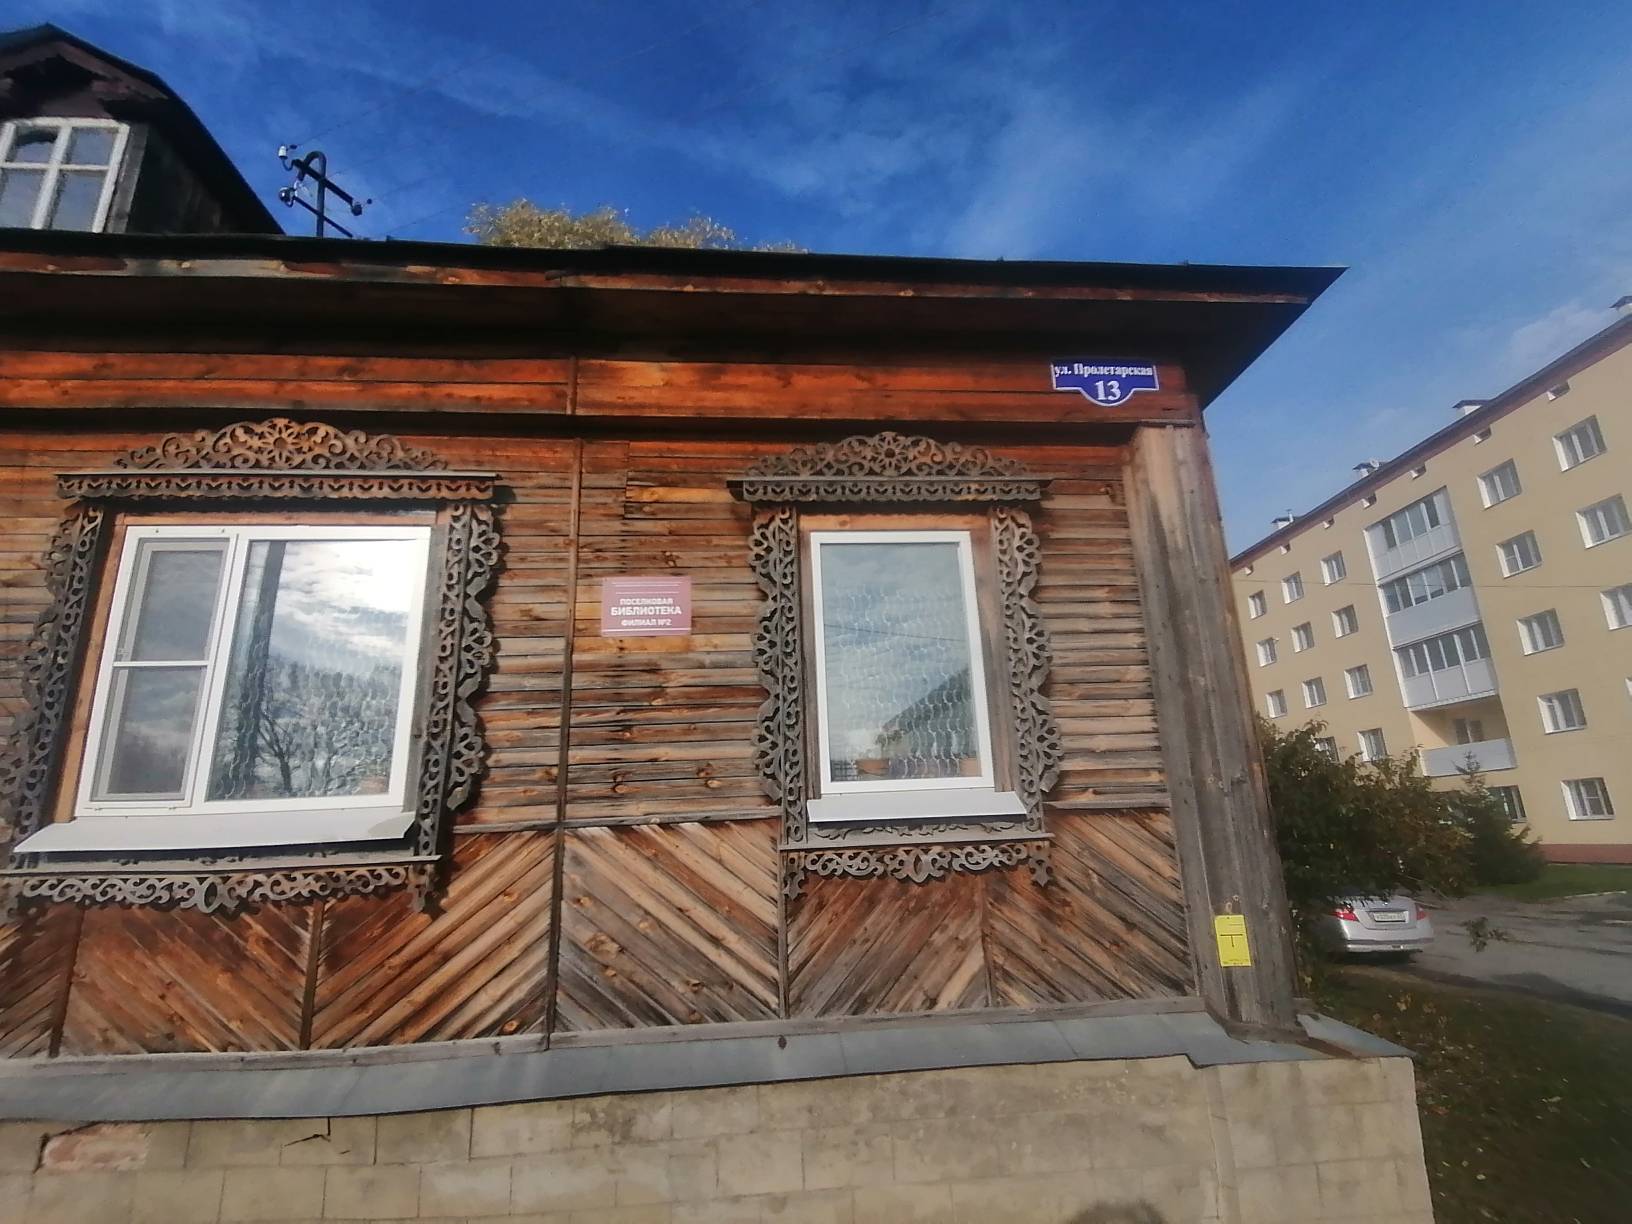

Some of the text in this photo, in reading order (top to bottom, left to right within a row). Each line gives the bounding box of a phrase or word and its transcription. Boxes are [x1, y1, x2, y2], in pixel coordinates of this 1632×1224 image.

[1055, 363, 1153, 378] ул. Пролетарская
[1094, 380, 1121, 401] 13
[611, 606, 682, 616] БИБЛИОТЕКА
